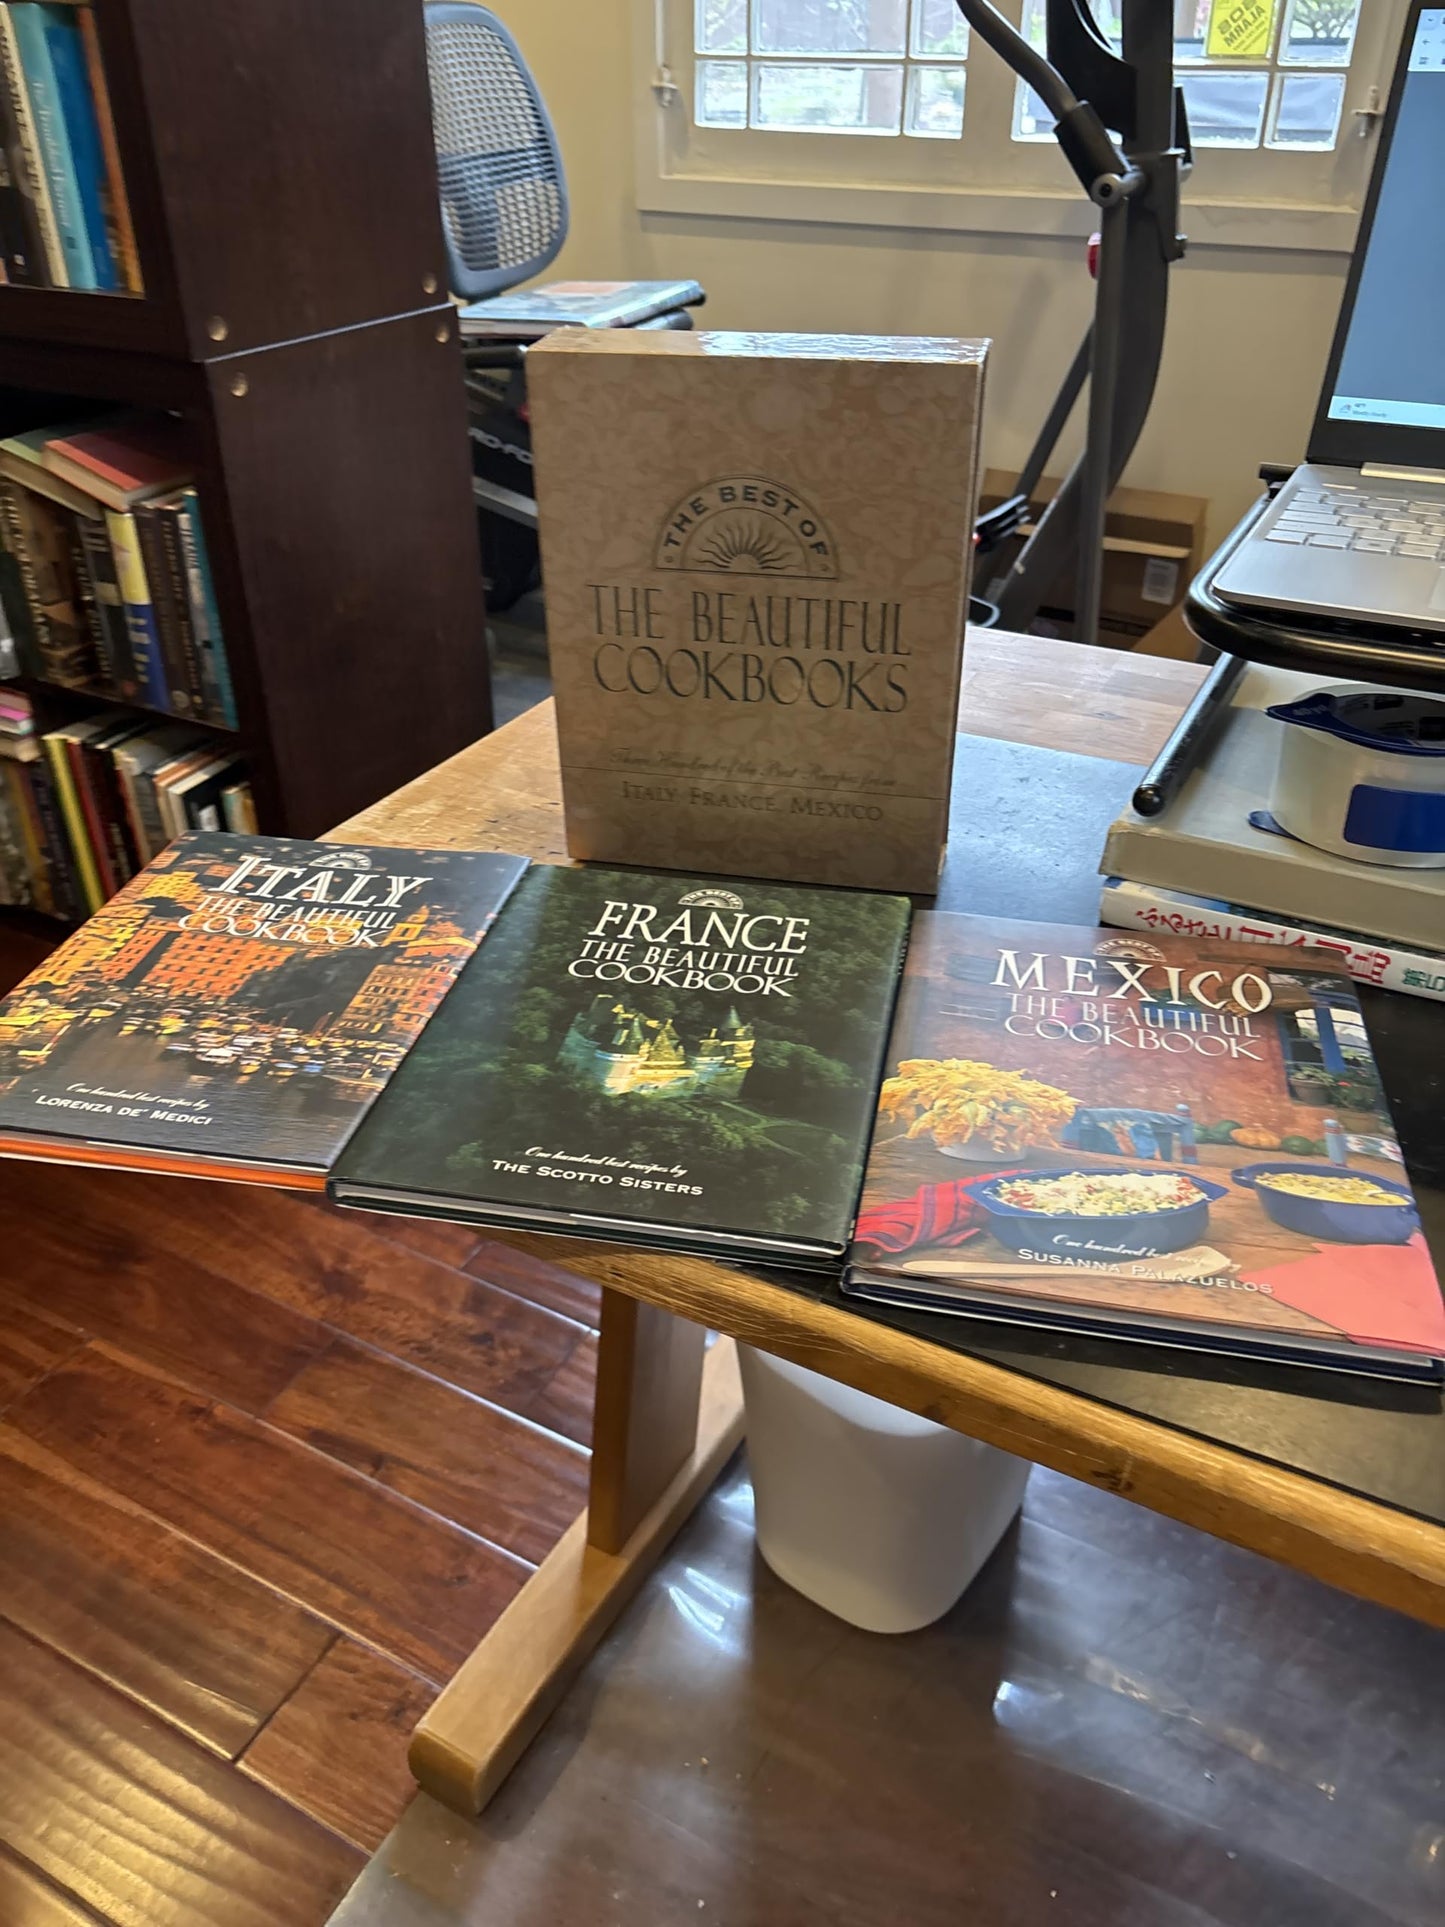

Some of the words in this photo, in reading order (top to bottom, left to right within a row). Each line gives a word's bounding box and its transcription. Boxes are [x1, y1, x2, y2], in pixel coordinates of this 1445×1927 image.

[664, 497, 709, 547] THE
[718, 484, 799, 516] BEST
[800, 520, 828, 555] OF
[587, 584, 664, 639] THE
[692, 591, 912, 656] BEAUTIFUL
[594, 642, 908, 713] COOKBOOKS
[790, 797, 883, 821] MEXICO
[208, 855, 433, 907] ITALY
[178, 913, 387, 947] COOKBOOK
[197, 895, 250, 916] THE
[254, 902, 399, 929] BEAUTIFUL
[587, 900, 810, 954] FRANCE
[568, 958, 795, 997] COOKBOOK
[580, 939, 635, 962] THE
[642, 946, 798, 977] BEAUTIFUL
[990, 949, 1272, 1014] MEXICO
[1005, 992, 1065, 1018] THE
[1082, 1001, 1261, 1038] BEAUTIFUL
[1005, 1015, 1263, 1061] COOKBOOK
[35, 1095, 112, 1113] LORENZA
[150, 1110, 212, 1125] MEDICI
[492, 1160, 531, 1174] THE
[536, 1166, 613, 1184] SCOTTO
[619, 1176, 704, 1196] SISTERS
[551, 1151, 605, 1165] hundred
[604, 1157, 630, 1168] best
[669, 1165, 689, 1177] by
[1084, 1240, 1147, 1257] hundred
[1017, 1249, 1121, 1274] SUSANNA
[1131, 1265, 1273, 1294] PALAZUELOS
